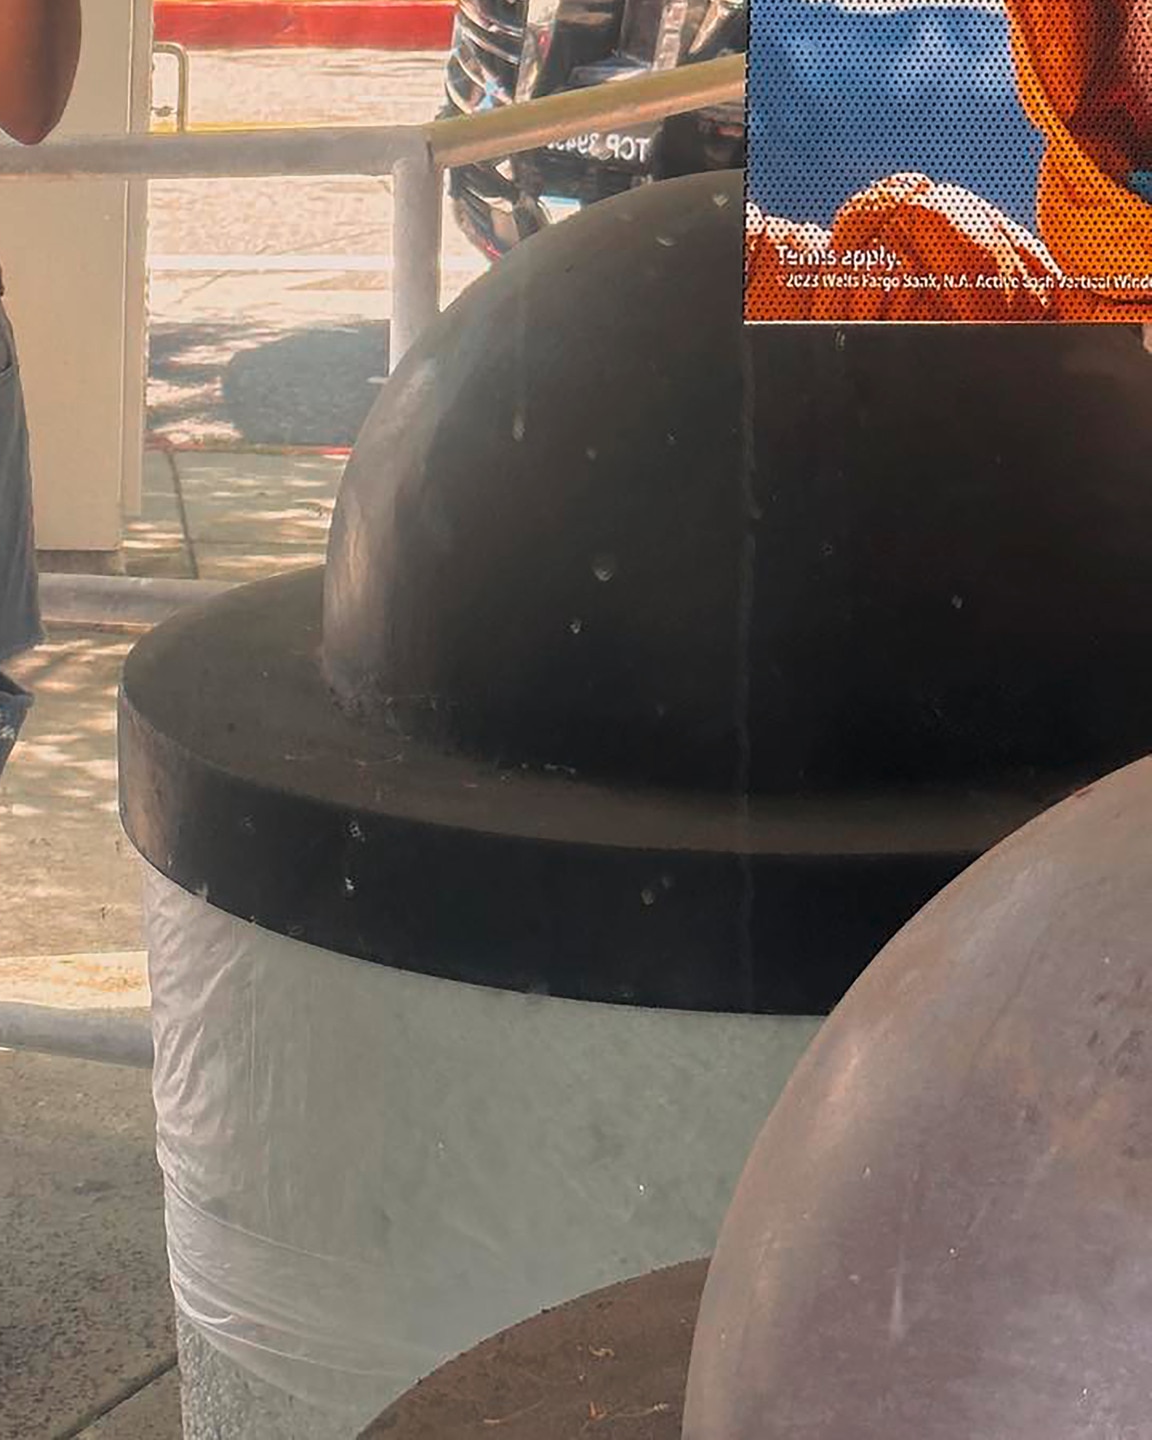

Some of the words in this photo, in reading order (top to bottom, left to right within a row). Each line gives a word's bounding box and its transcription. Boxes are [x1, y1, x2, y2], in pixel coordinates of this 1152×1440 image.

[774, 245, 837, 265] Terms
[840, 245, 902, 271] apply.
[822, 273, 859, 288] Wells
[862, 273, 900, 292] Fargo
[943, 273, 973, 289] N.A.
[1113, 273, 1152, 289] Wind
